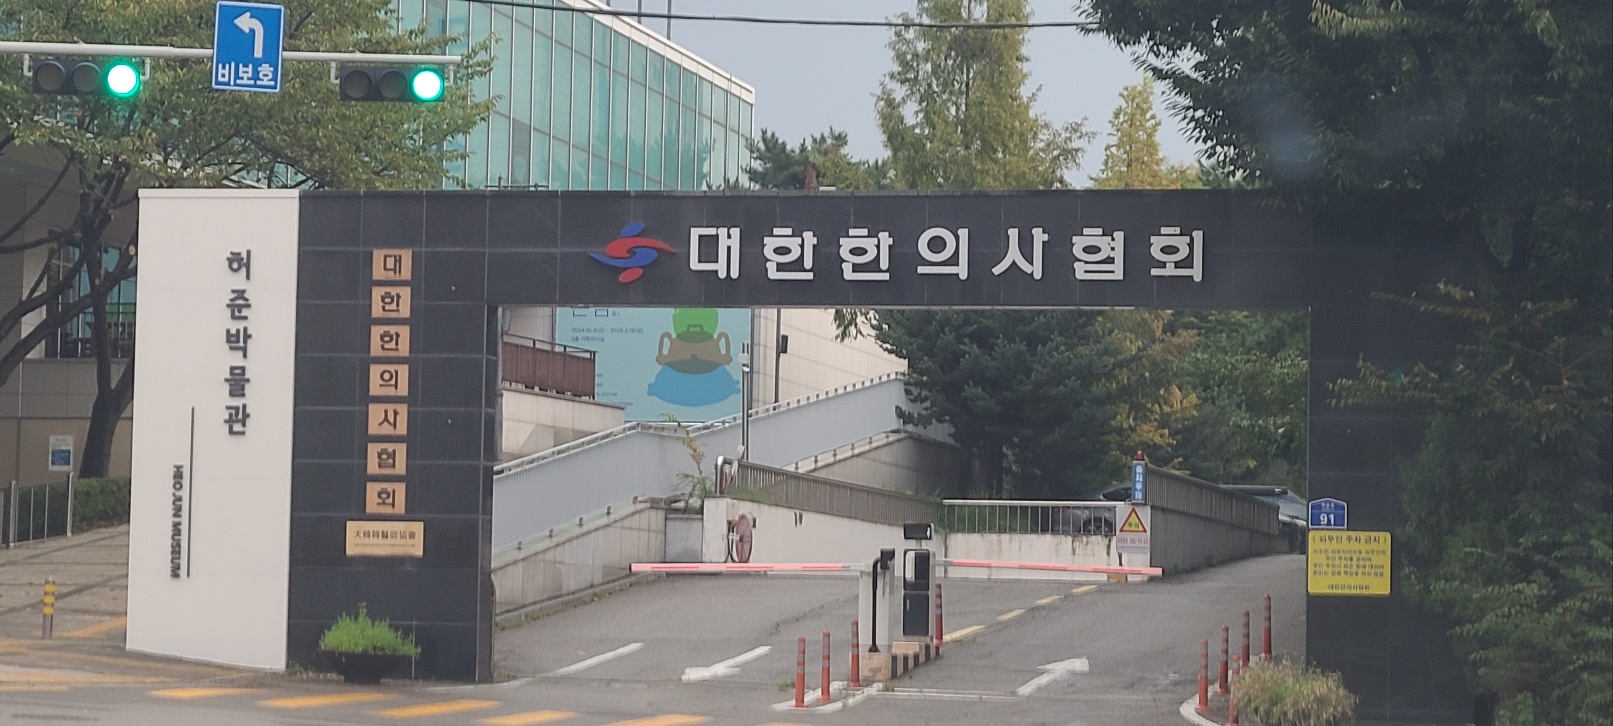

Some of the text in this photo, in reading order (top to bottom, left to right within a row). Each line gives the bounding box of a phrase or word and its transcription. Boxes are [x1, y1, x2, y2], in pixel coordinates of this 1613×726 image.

[217, 61, 275, 87] 비보호
[688, 226, 1205, 282] 대한한의사협회
[223, 249, 252, 437] 허준박물관
[376, 253, 402, 509] 대한한의사협회
[170, 464, 184, 578] HEO JUN MUSEUM
[1319, 513, 1335, 525] 91
